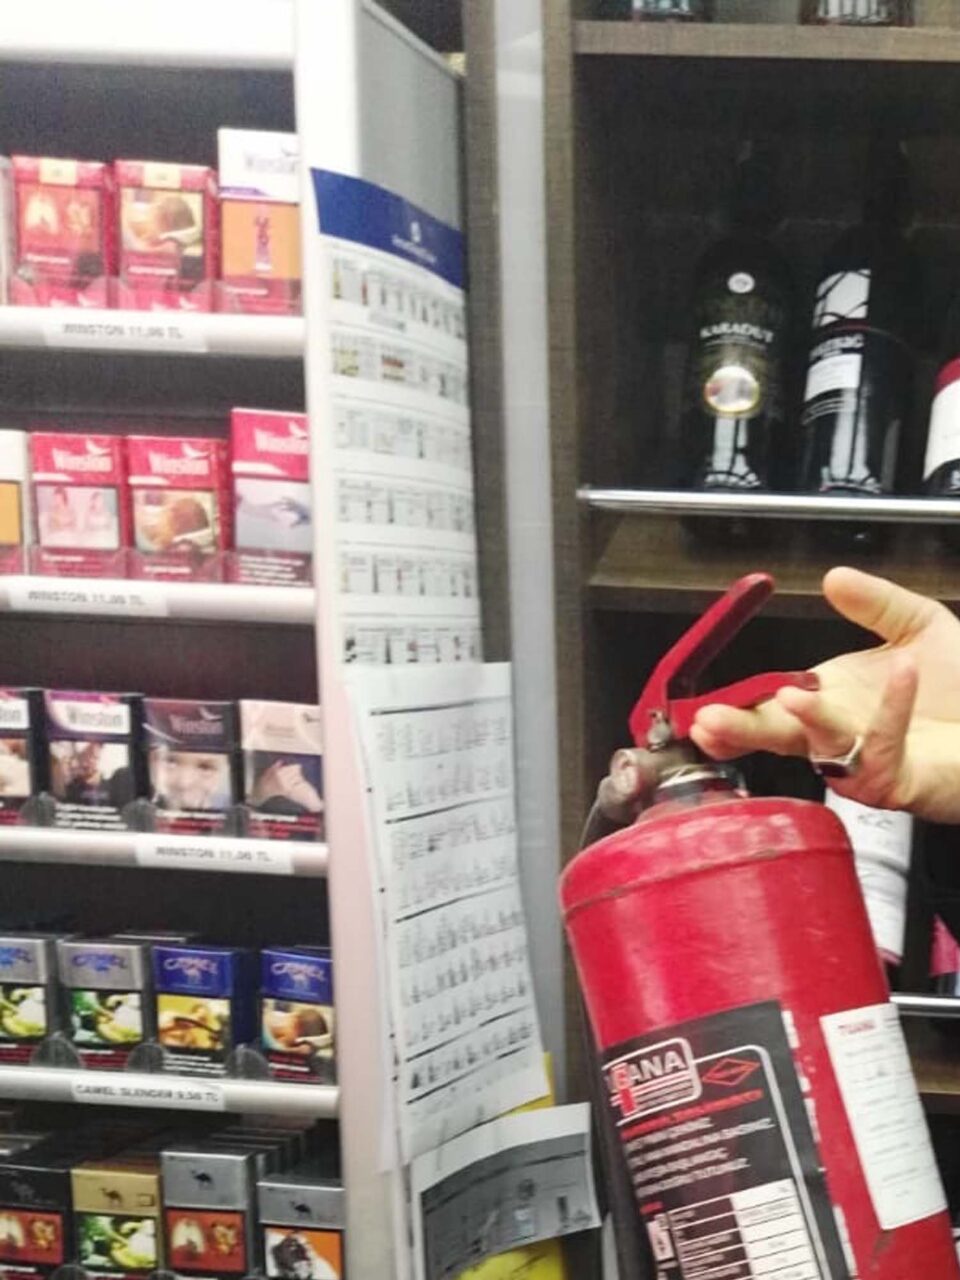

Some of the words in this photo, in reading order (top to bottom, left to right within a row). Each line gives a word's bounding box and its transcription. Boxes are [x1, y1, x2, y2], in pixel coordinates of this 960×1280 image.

[163, 955, 220, 976] CAMEL
[270, 961, 326, 983] CAMEL
[75, 1083, 116, 1097] CAMEL
